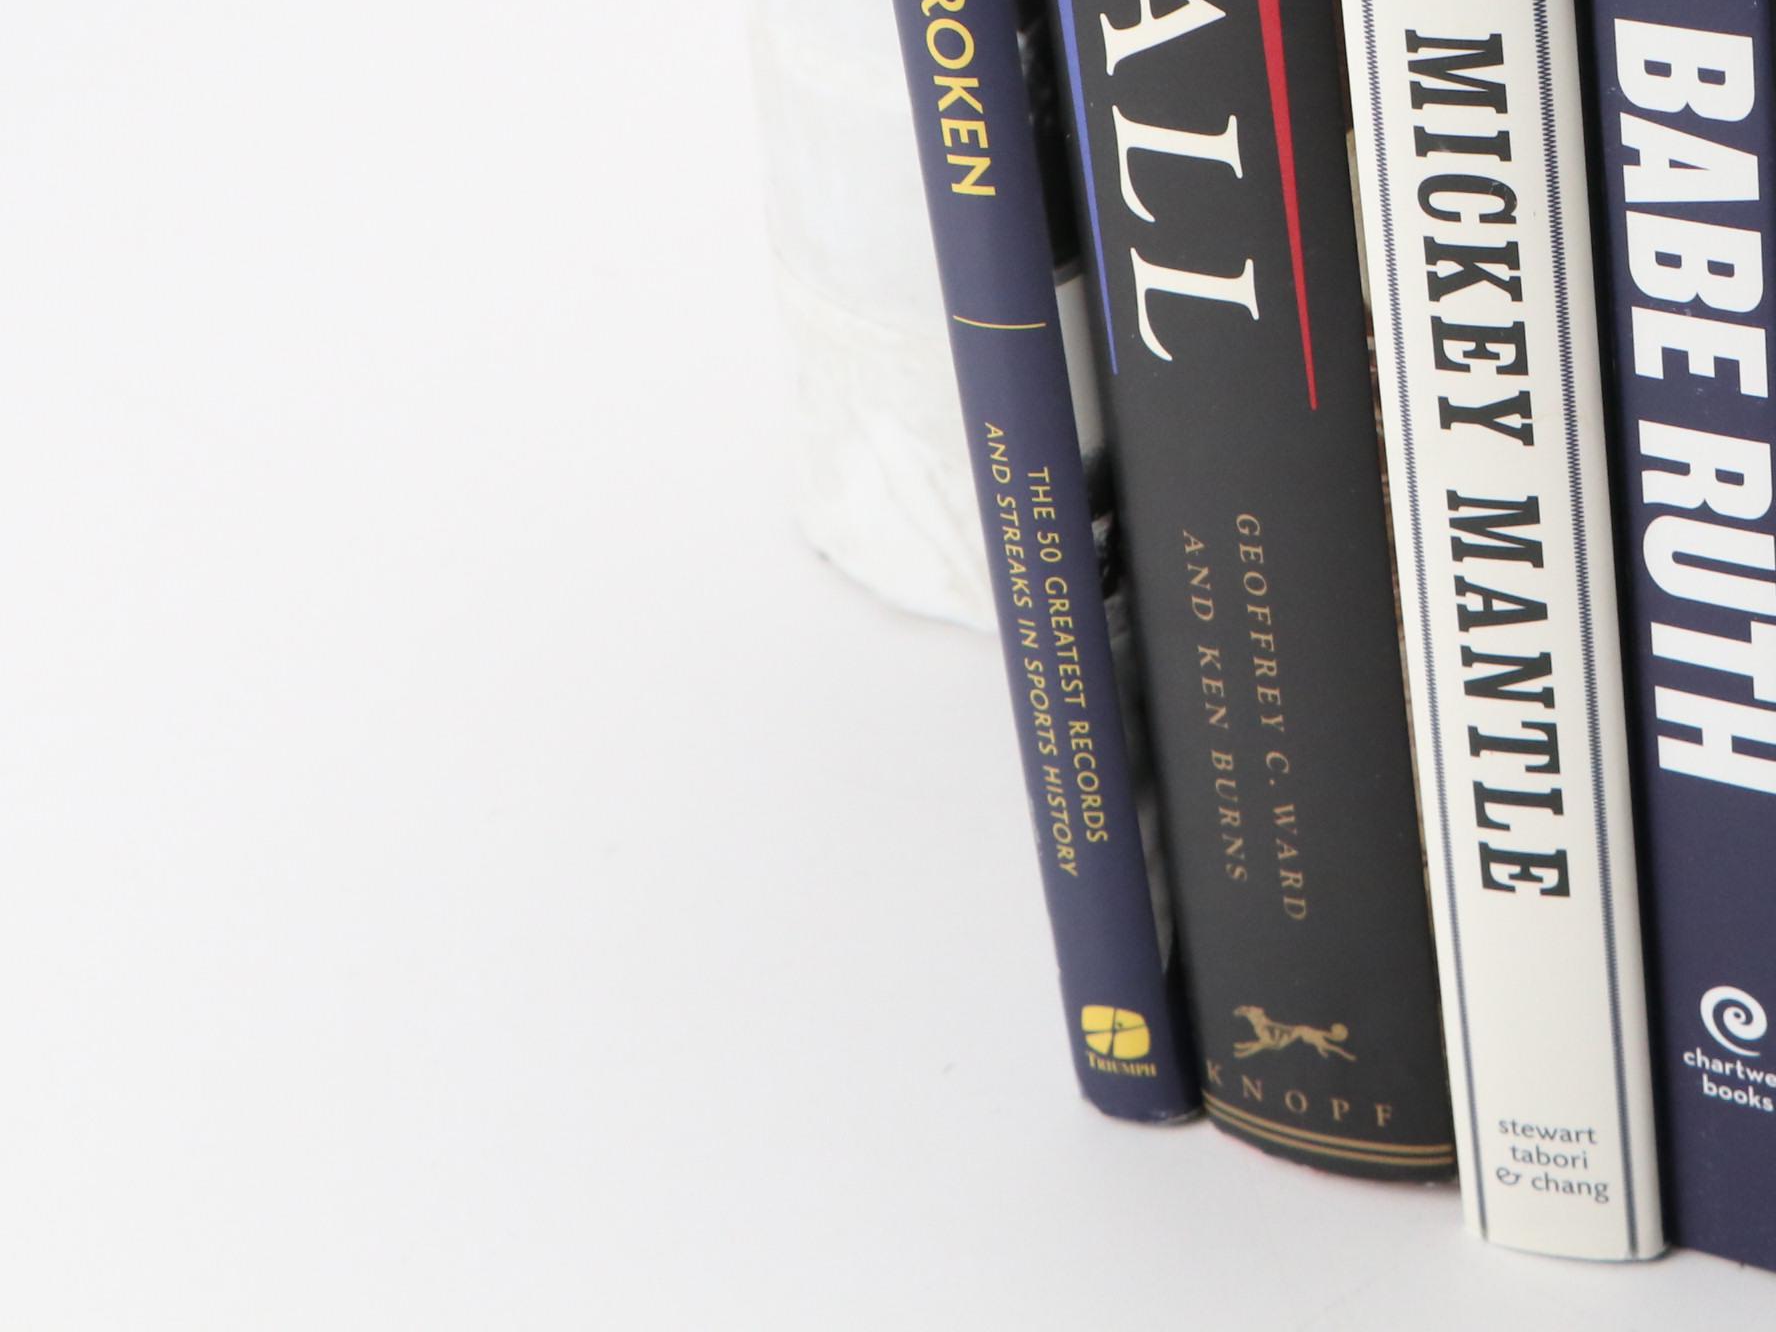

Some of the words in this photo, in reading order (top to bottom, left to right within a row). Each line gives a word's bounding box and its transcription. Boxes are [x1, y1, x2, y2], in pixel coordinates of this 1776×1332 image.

[1404, 28, 1536, 447] MICKEY
[1613, 17, 1769, 400] BABE
[985, 422, 1010, 484] AND
[1028, 467, 1055, 521] THE
[996, 493, 1032, 609] STREAKS
[1037, 531, 1062, 563] 50
[1183, 530, 1215, 622] AND
[1018, 618, 1039, 648] IN
[1045, 576, 1086, 708] GREATEST
[1235, 512, 1285, 733] GEOFFREY
[1024, 658, 1057, 756] SPORTS
[1197, 644, 1229, 729] KEN
[1446, 488, 1572, 900] MANTLE
[1069, 720, 1109, 843] RECORDS
[1265, 750, 1290, 787] C.
[1043, 764, 1078, 877] HISTORY
[1211, 749, 1248, 882] BURNS
[1273, 803, 1308, 921] WARD
[1205, 1059, 1394, 1128] KNOPF
[1498, 1119, 1598, 1145] stewart
[1702, 1074, 1775, 1112] books
[1495, 1167, 1522, 1186] &
[1531, 1171, 1609, 1204] chang
[1510, 1145, 1588, 1169] tabori
